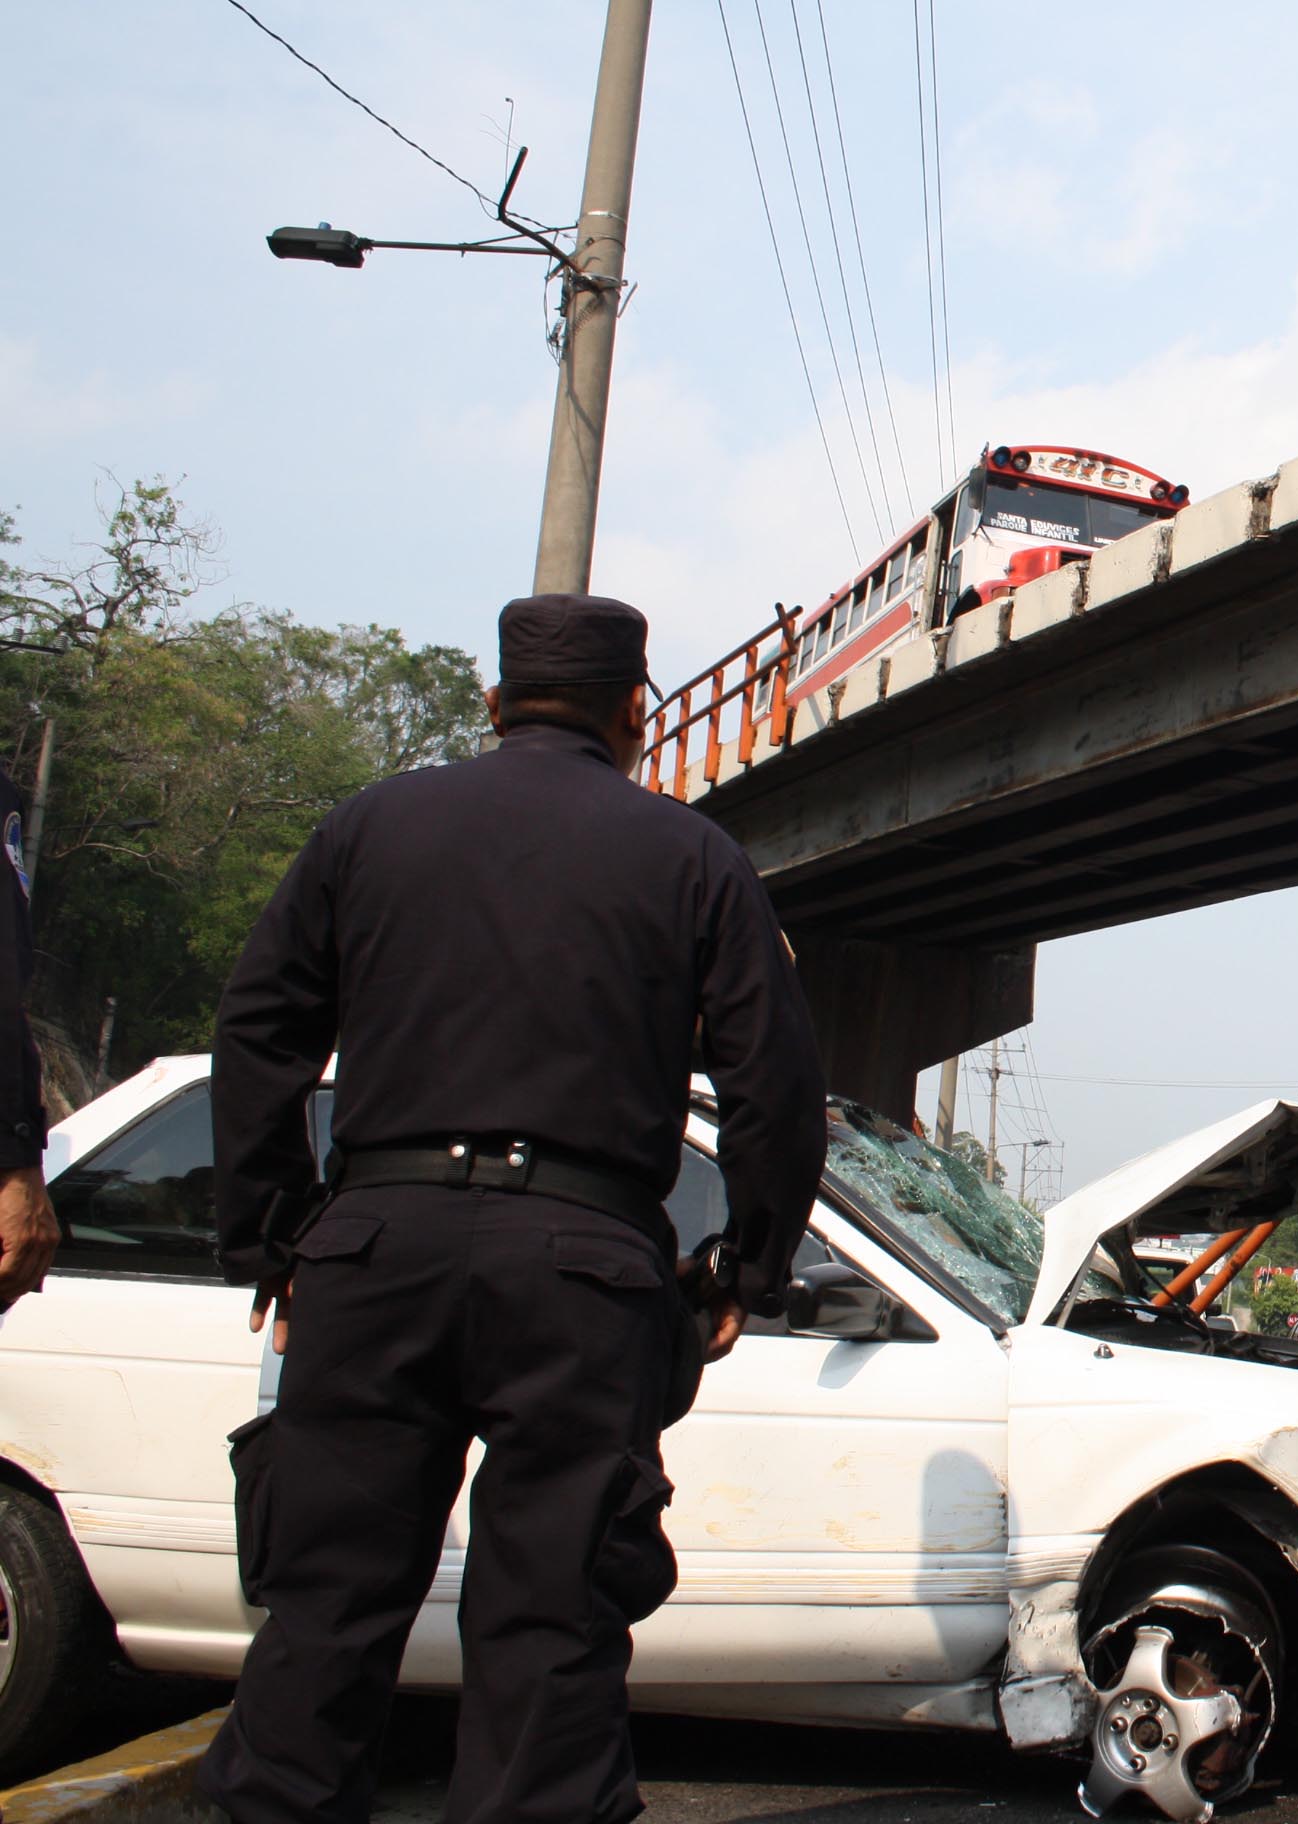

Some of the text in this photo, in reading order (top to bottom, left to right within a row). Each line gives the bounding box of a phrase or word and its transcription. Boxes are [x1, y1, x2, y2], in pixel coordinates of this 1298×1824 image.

[997, 512, 1027, 527] SANTA
[990, 518, 1027, 533] PARQUE
[1031, 526, 1079, 543] INFANTIL
